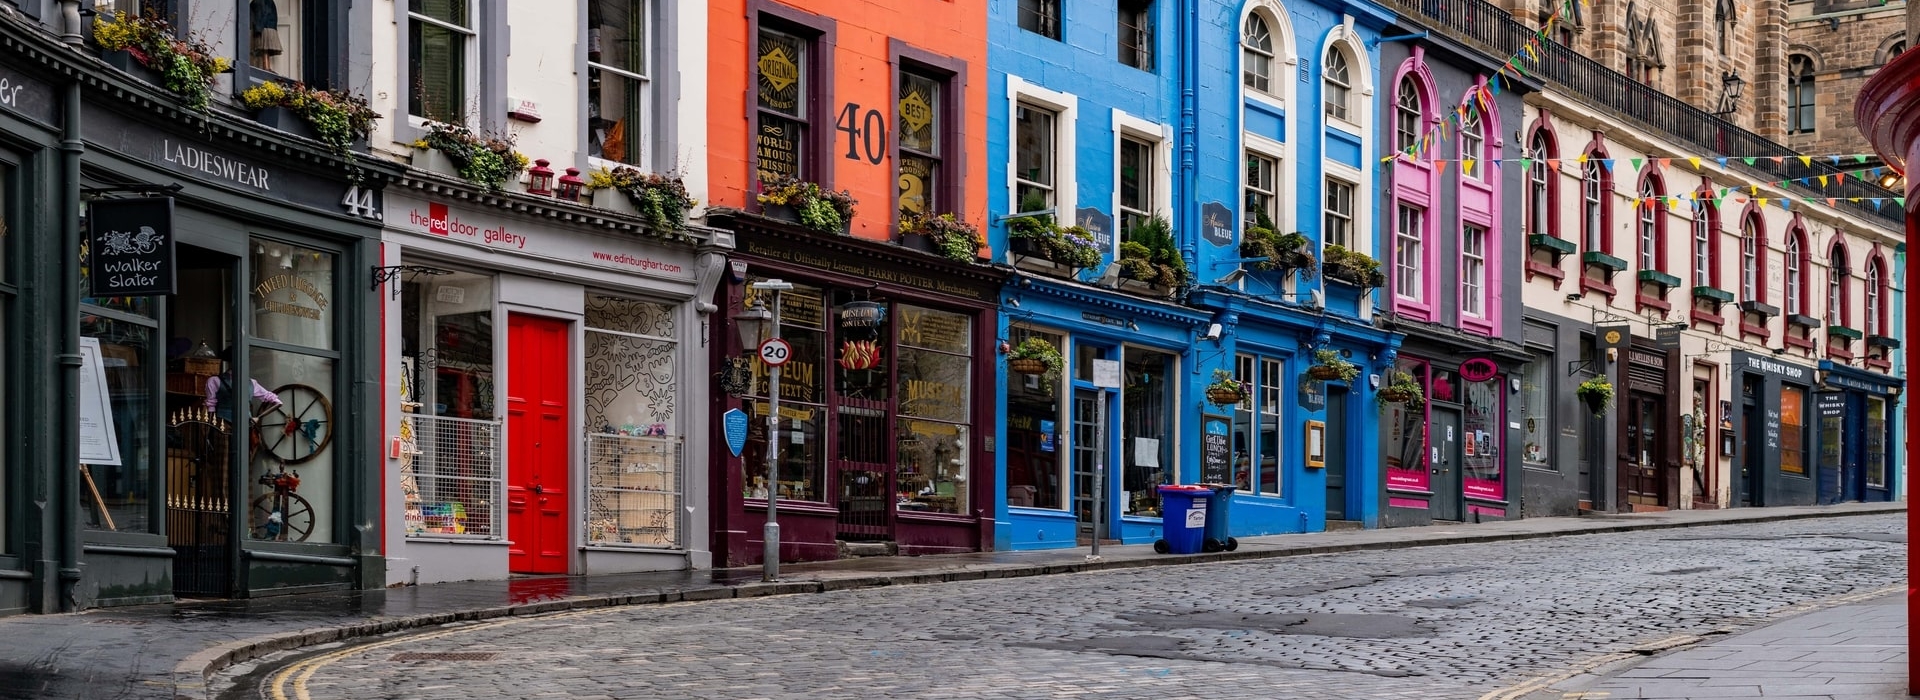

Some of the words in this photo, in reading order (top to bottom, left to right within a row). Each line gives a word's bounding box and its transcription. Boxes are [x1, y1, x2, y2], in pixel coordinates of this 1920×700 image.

[763, 59, 795, 79] ORIGINAL
[905, 103, 926, 120] BEST
[757, 135, 792, 151] WORLD
[836, 102, 886, 165] 40
[164, 139, 270, 191] LADIESWEAR
[410, 208, 429, 227] the
[430, 215, 448, 231] red
[450, 217, 479, 237] door
[484, 226, 526, 249] gallery
[1214, 226, 1232, 240] BLEUE
[104, 258, 161, 273] walker
[592, 251, 682, 273] www.edinburghart.com
[748, 241, 781, 257] Retailer
[782, 249, 791, 260] of
[794, 252, 832, 270] Officially
[833, 259, 865, 275] Licensed
[868, 266, 898, 282] HARRY
[900, 273, 933, 289] POTTER
[255, 274, 288, 299] TWEED
[763, 346, 787, 359] 20
[750, 355, 814, 387] MUEUM
[1748, 357, 1760, 369] THE
[1761, 358, 1785, 374] WHISKY
[1786, 366, 1802, 378] SHOP
[762, 381, 802, 398] CTEXT
